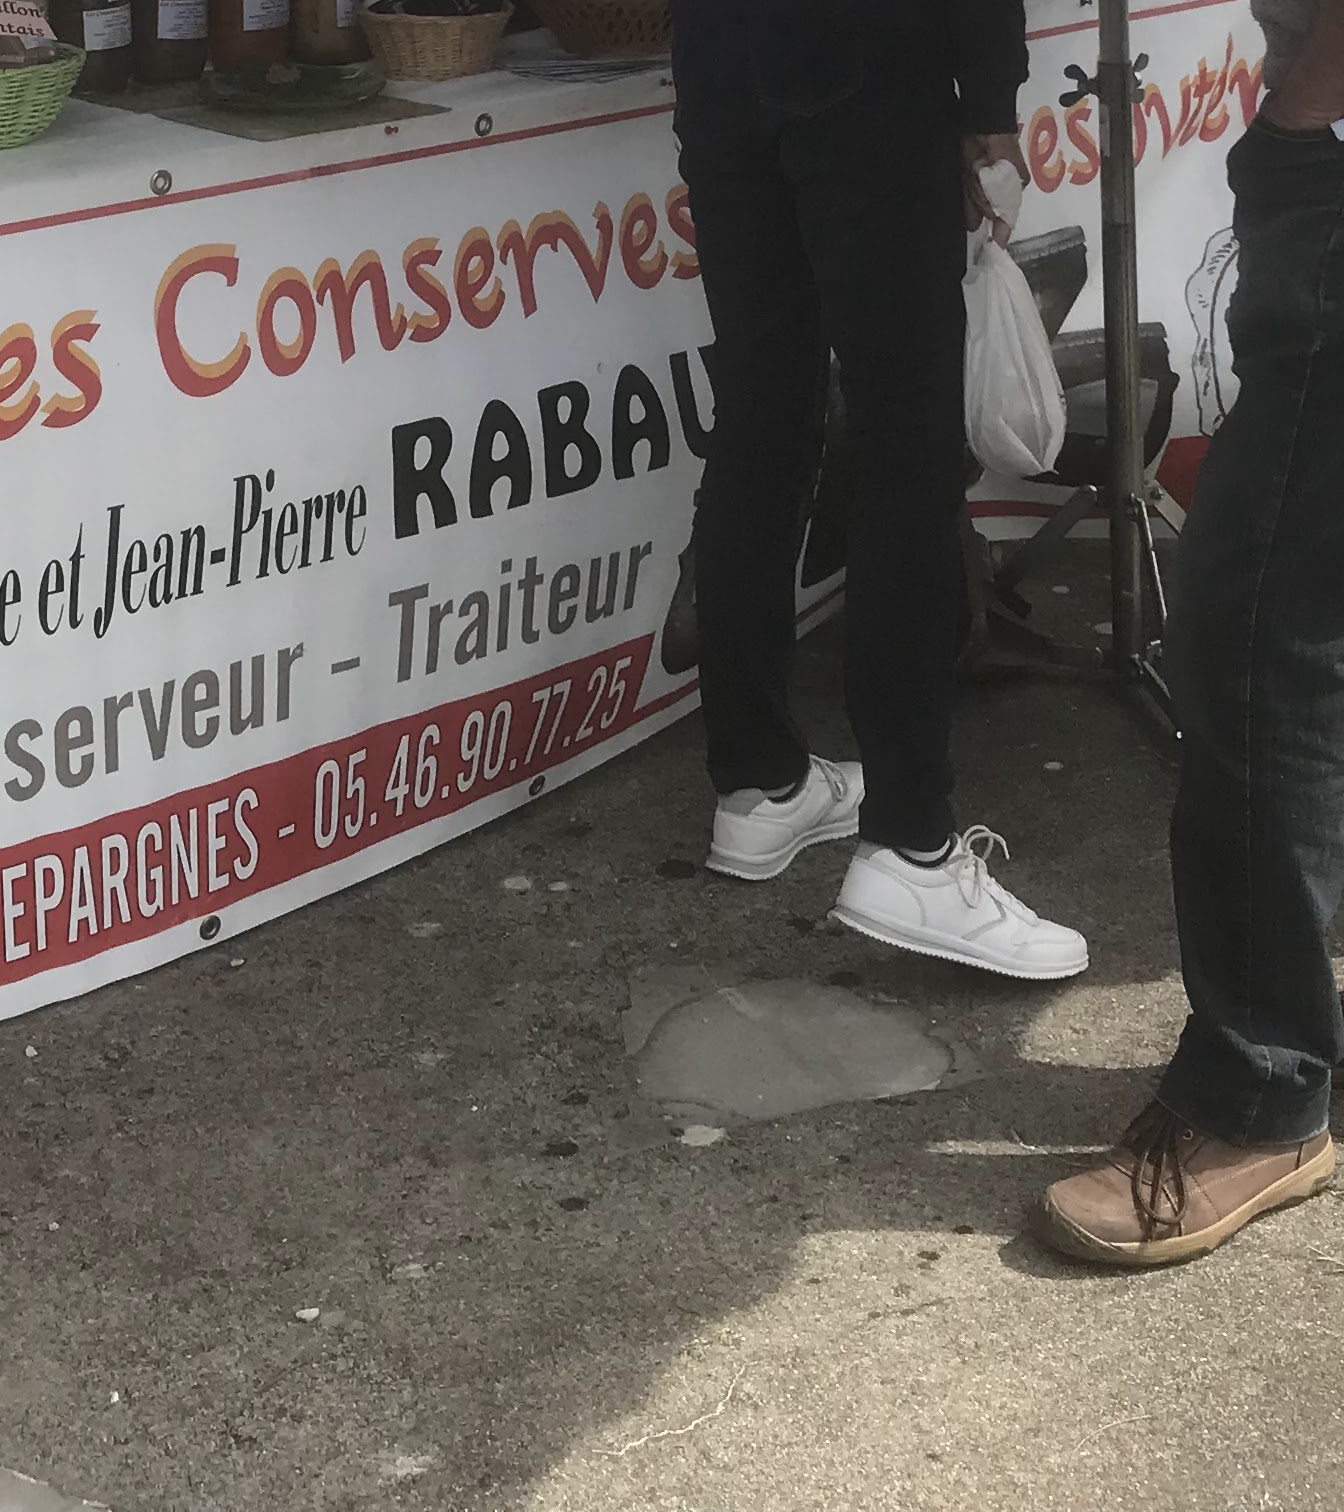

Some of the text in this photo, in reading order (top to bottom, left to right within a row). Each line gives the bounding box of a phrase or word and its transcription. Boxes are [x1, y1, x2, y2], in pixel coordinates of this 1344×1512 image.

[154, 183, 701, 397] Conserves
[1017, 98, 1101, 194] es
[38, 521, 85, 636] et
[94, 468, 367, 639] Jean-Pierre
[388, 540, 653, 683] Traiteur
[2, 787, 260, 963] EPARGNES
[313, 656, 633, 850] 05.46.90.77.25
